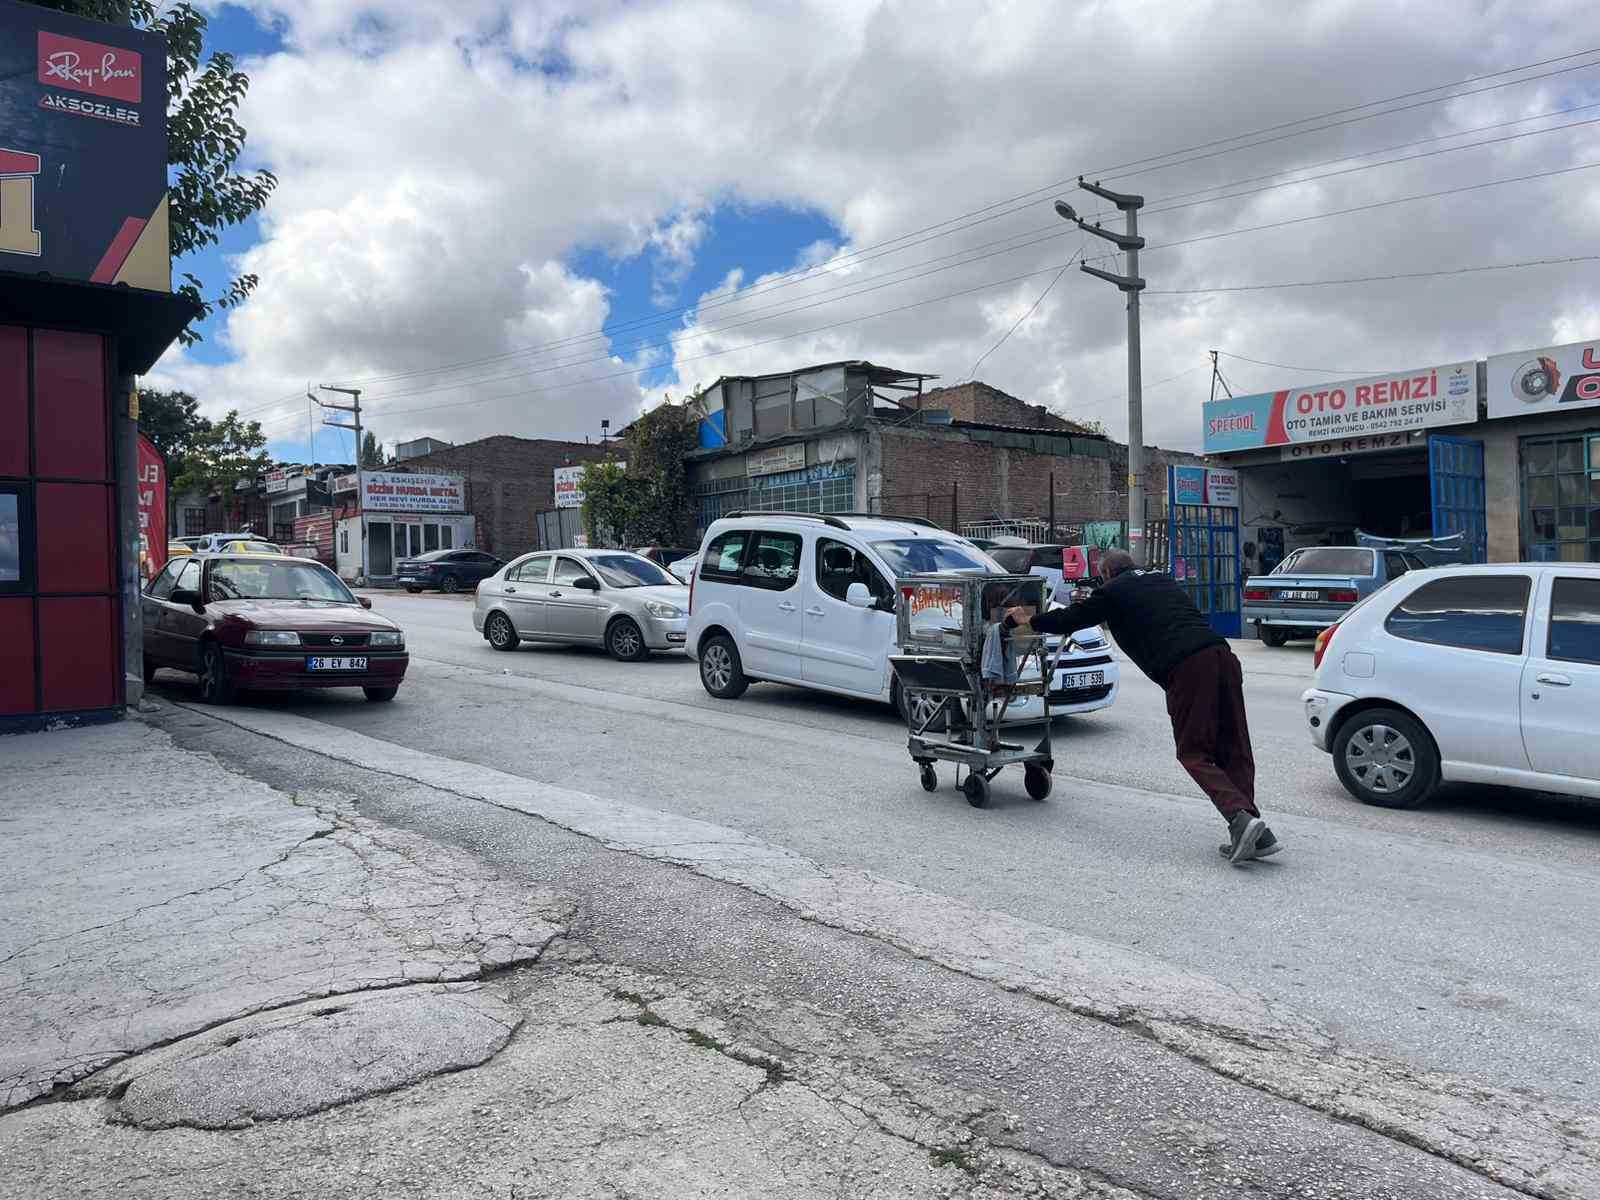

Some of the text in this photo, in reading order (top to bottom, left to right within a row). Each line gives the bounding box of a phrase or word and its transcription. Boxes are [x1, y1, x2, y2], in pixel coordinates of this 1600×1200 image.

[1297, 389, 1346, 414] OTO
[1355, 369, 1438, 408] REMZİ
[1286, 400, 1447, 431] OTO TAMİR VE BAKIM SERVİSİ
[1292, 443, 1331, 457] OTO
[313, 658, 324, 669] 26
